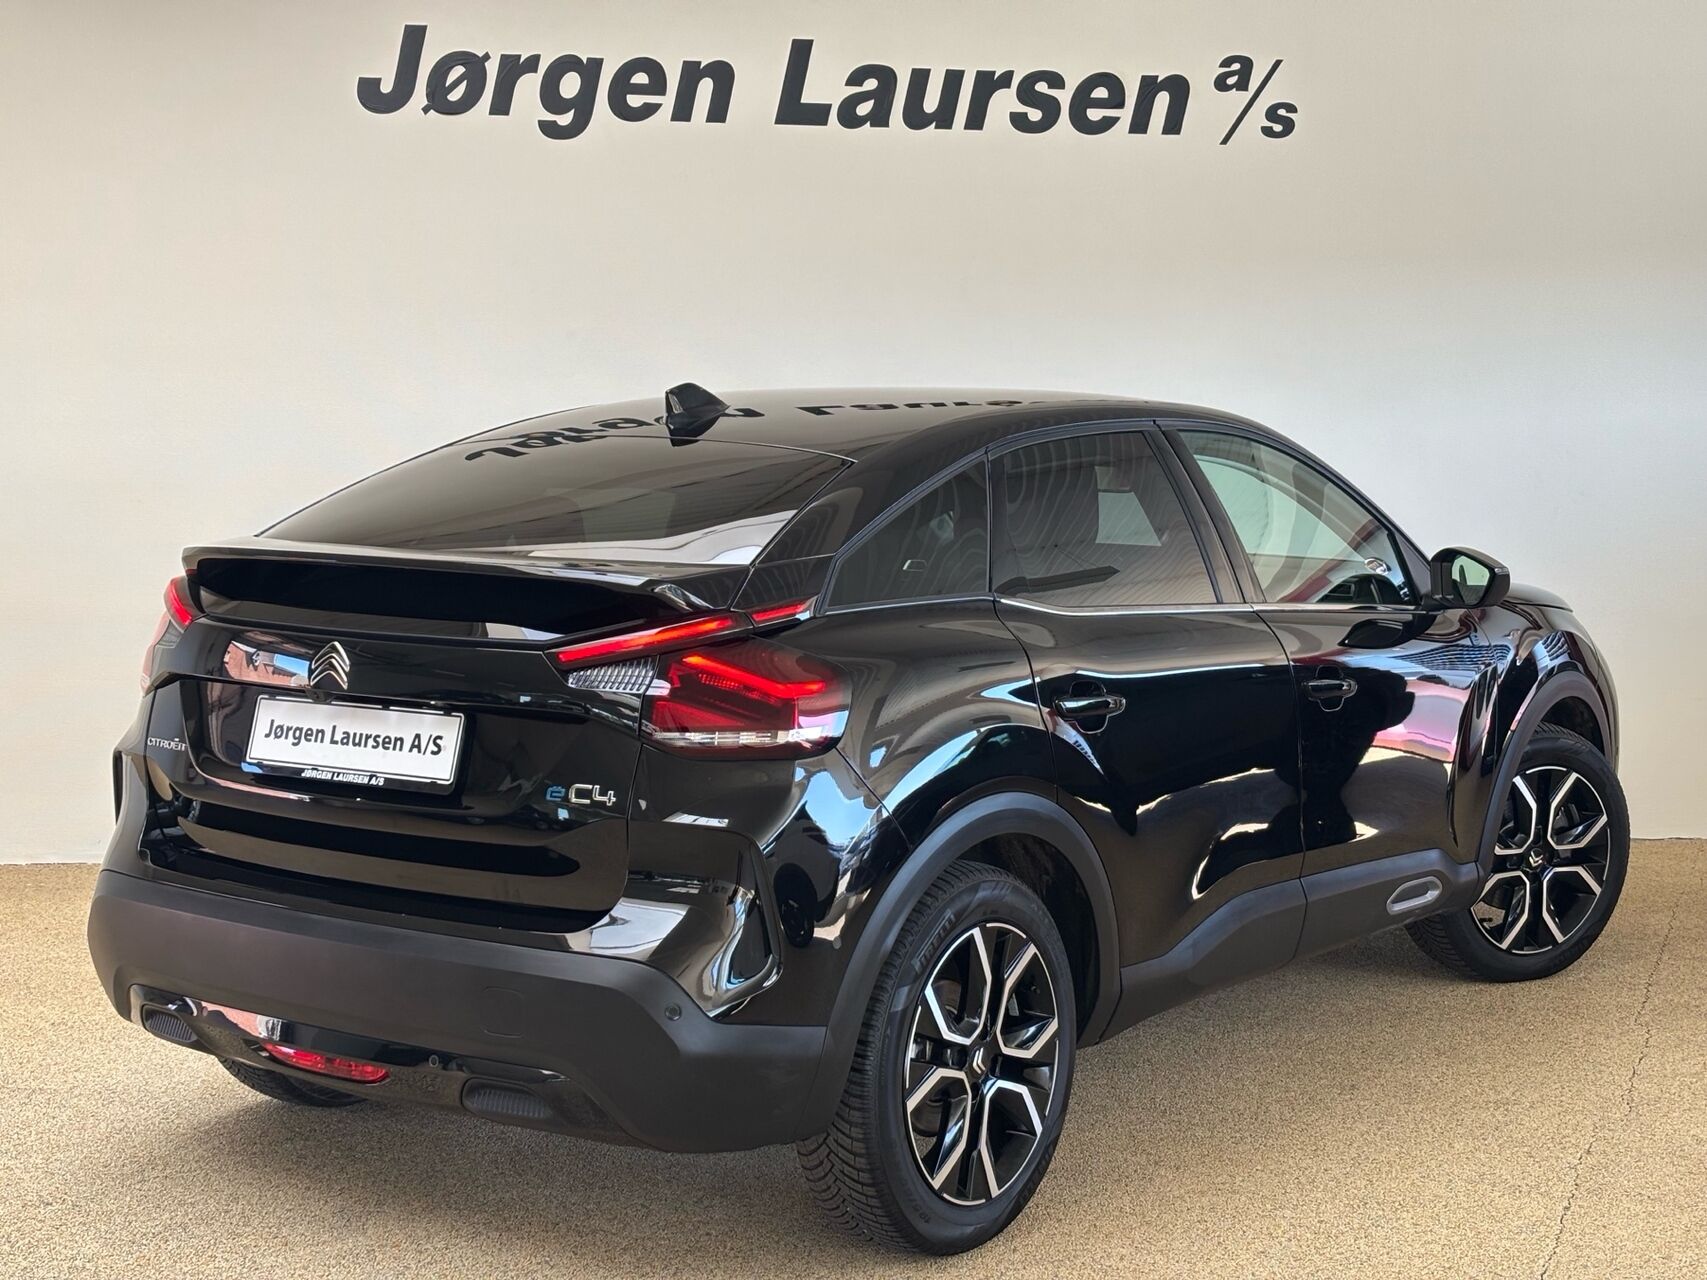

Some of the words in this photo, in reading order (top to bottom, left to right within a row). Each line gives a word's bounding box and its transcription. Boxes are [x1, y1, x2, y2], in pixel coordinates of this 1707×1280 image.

[356, 24, 736, 141] Jørgen
[774, 38, 1191, 136] Laursen
[1213, 54, 1299, 146] a/s
[264, 719, 326, 747] Jørgen
[329, 724, 405, 752] Laursen
[408, 733, 444, 756] A/S
[333, 773, 370, 784] LAURSEN
[369, 776, 385, 786] A/S
